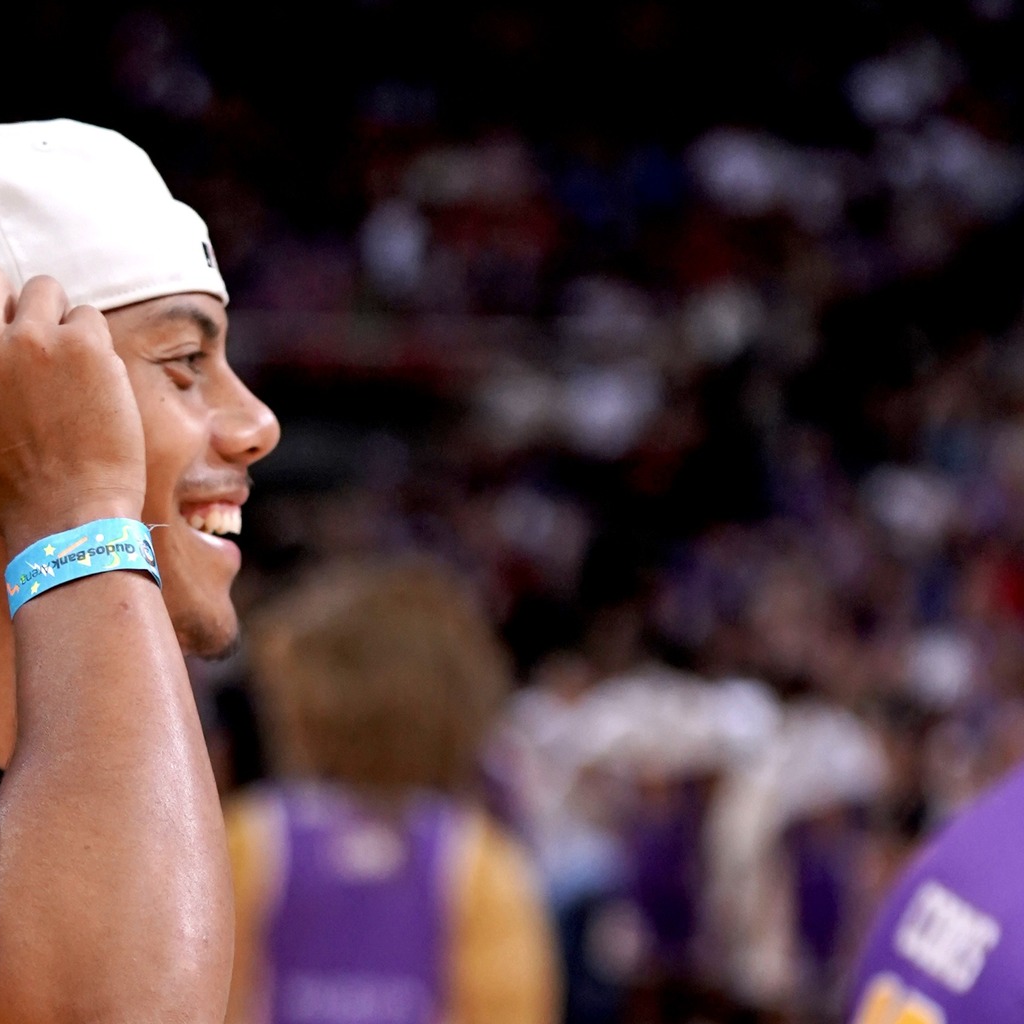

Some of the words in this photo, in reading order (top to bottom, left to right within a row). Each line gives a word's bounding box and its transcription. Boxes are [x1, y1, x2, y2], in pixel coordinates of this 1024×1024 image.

[87, 543, 136, 557] Qudos
[52, 551, 86, 569] Bank
[20, 562, 52, 585] Arena
